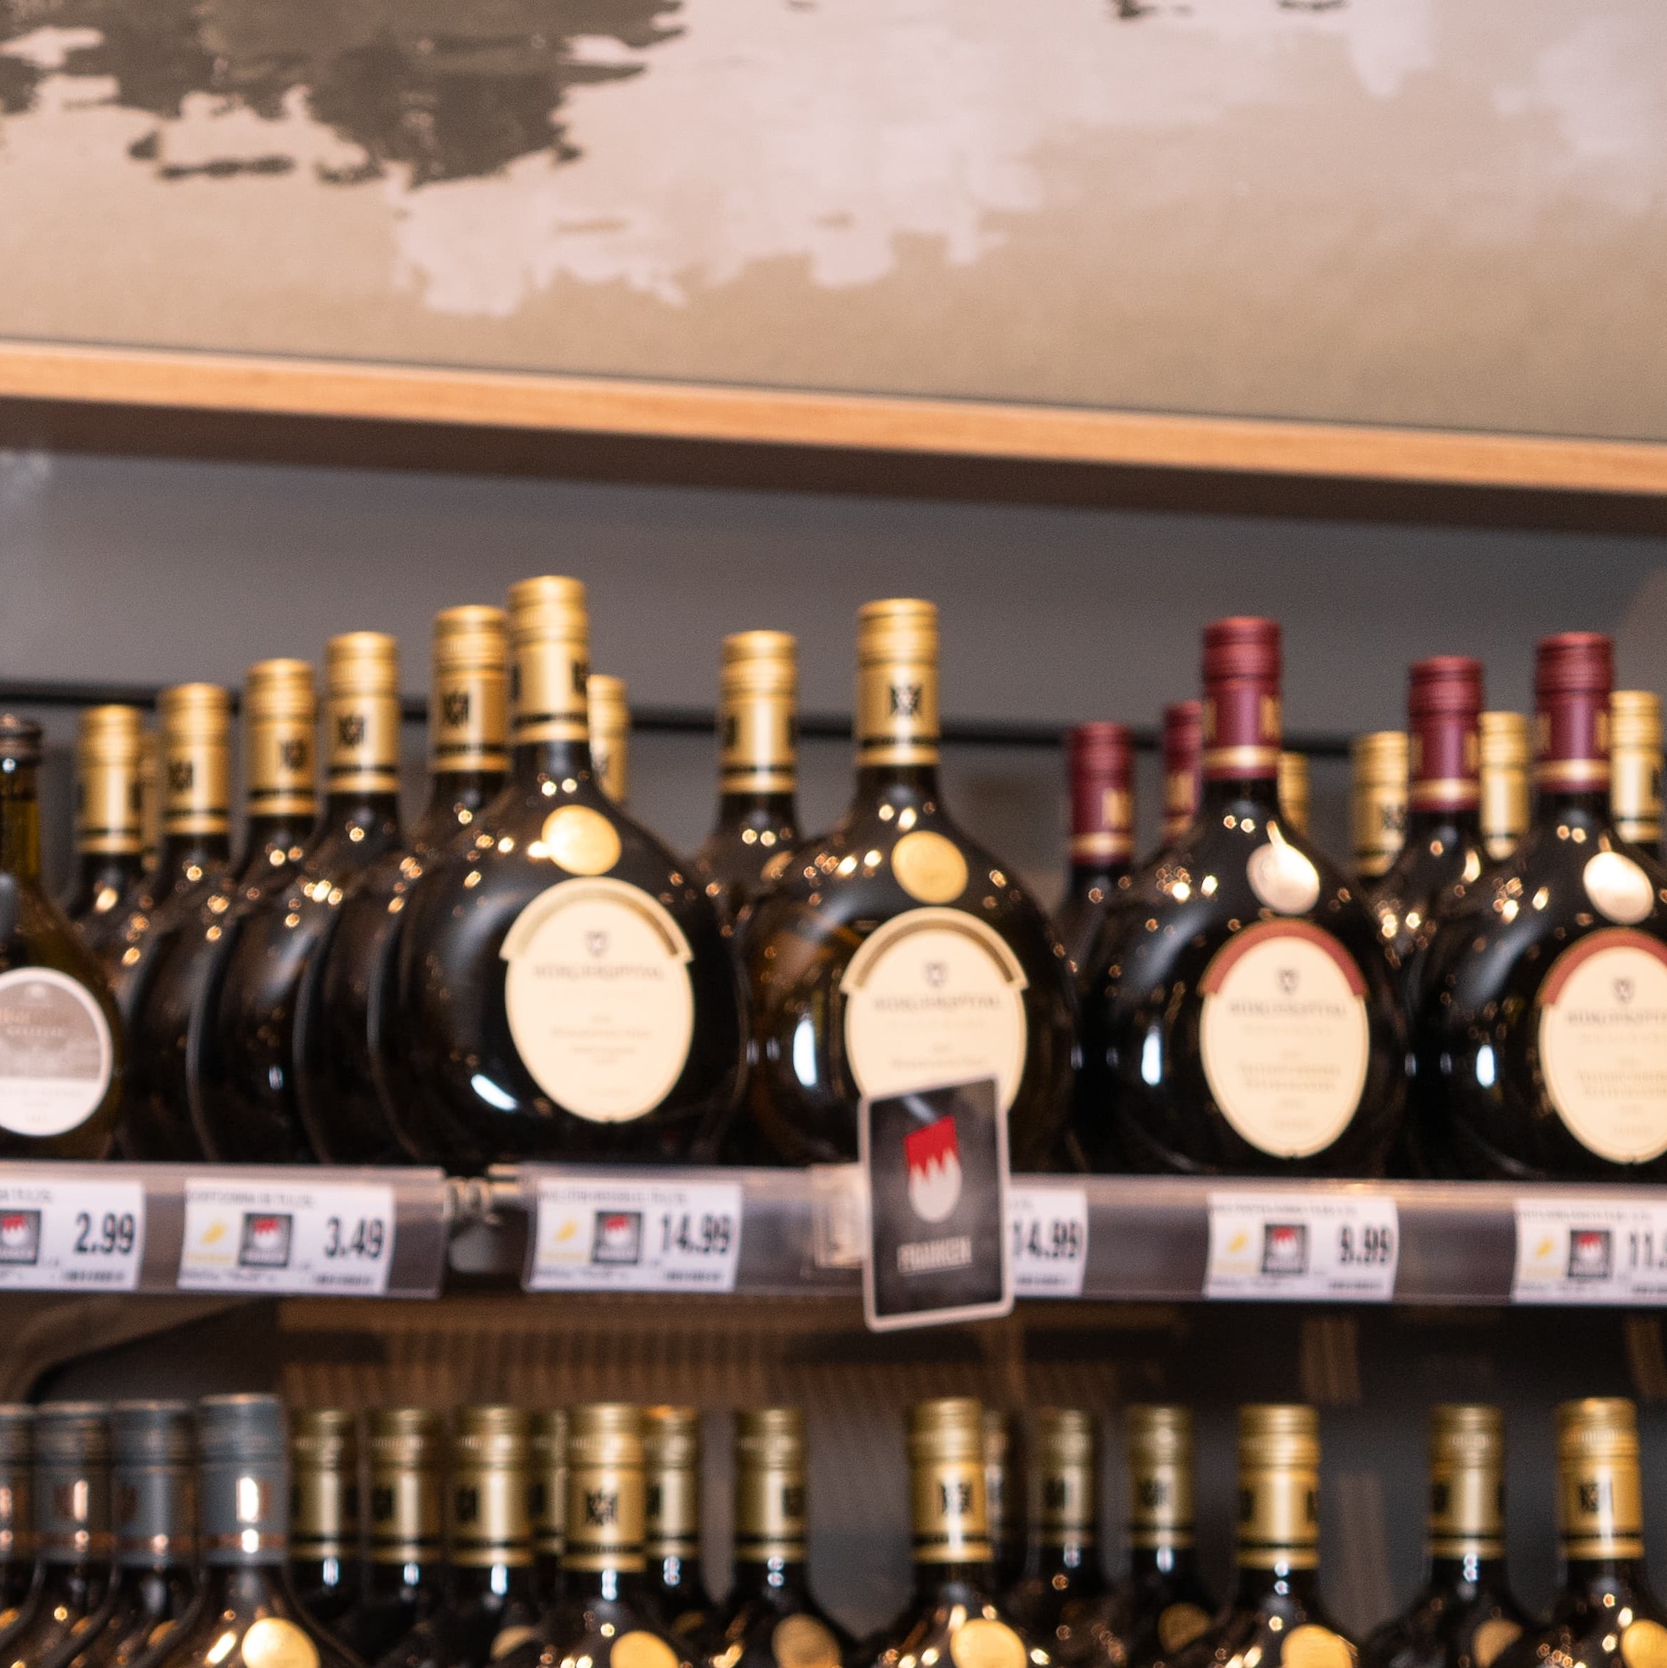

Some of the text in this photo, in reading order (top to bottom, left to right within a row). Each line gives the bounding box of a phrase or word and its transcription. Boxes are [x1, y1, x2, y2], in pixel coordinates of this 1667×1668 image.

[75, 1211, 136, 1255] 2.99
[325, 1215, 386, 1260] 3.49
[660, 1210, 733, 1254] 14.99
